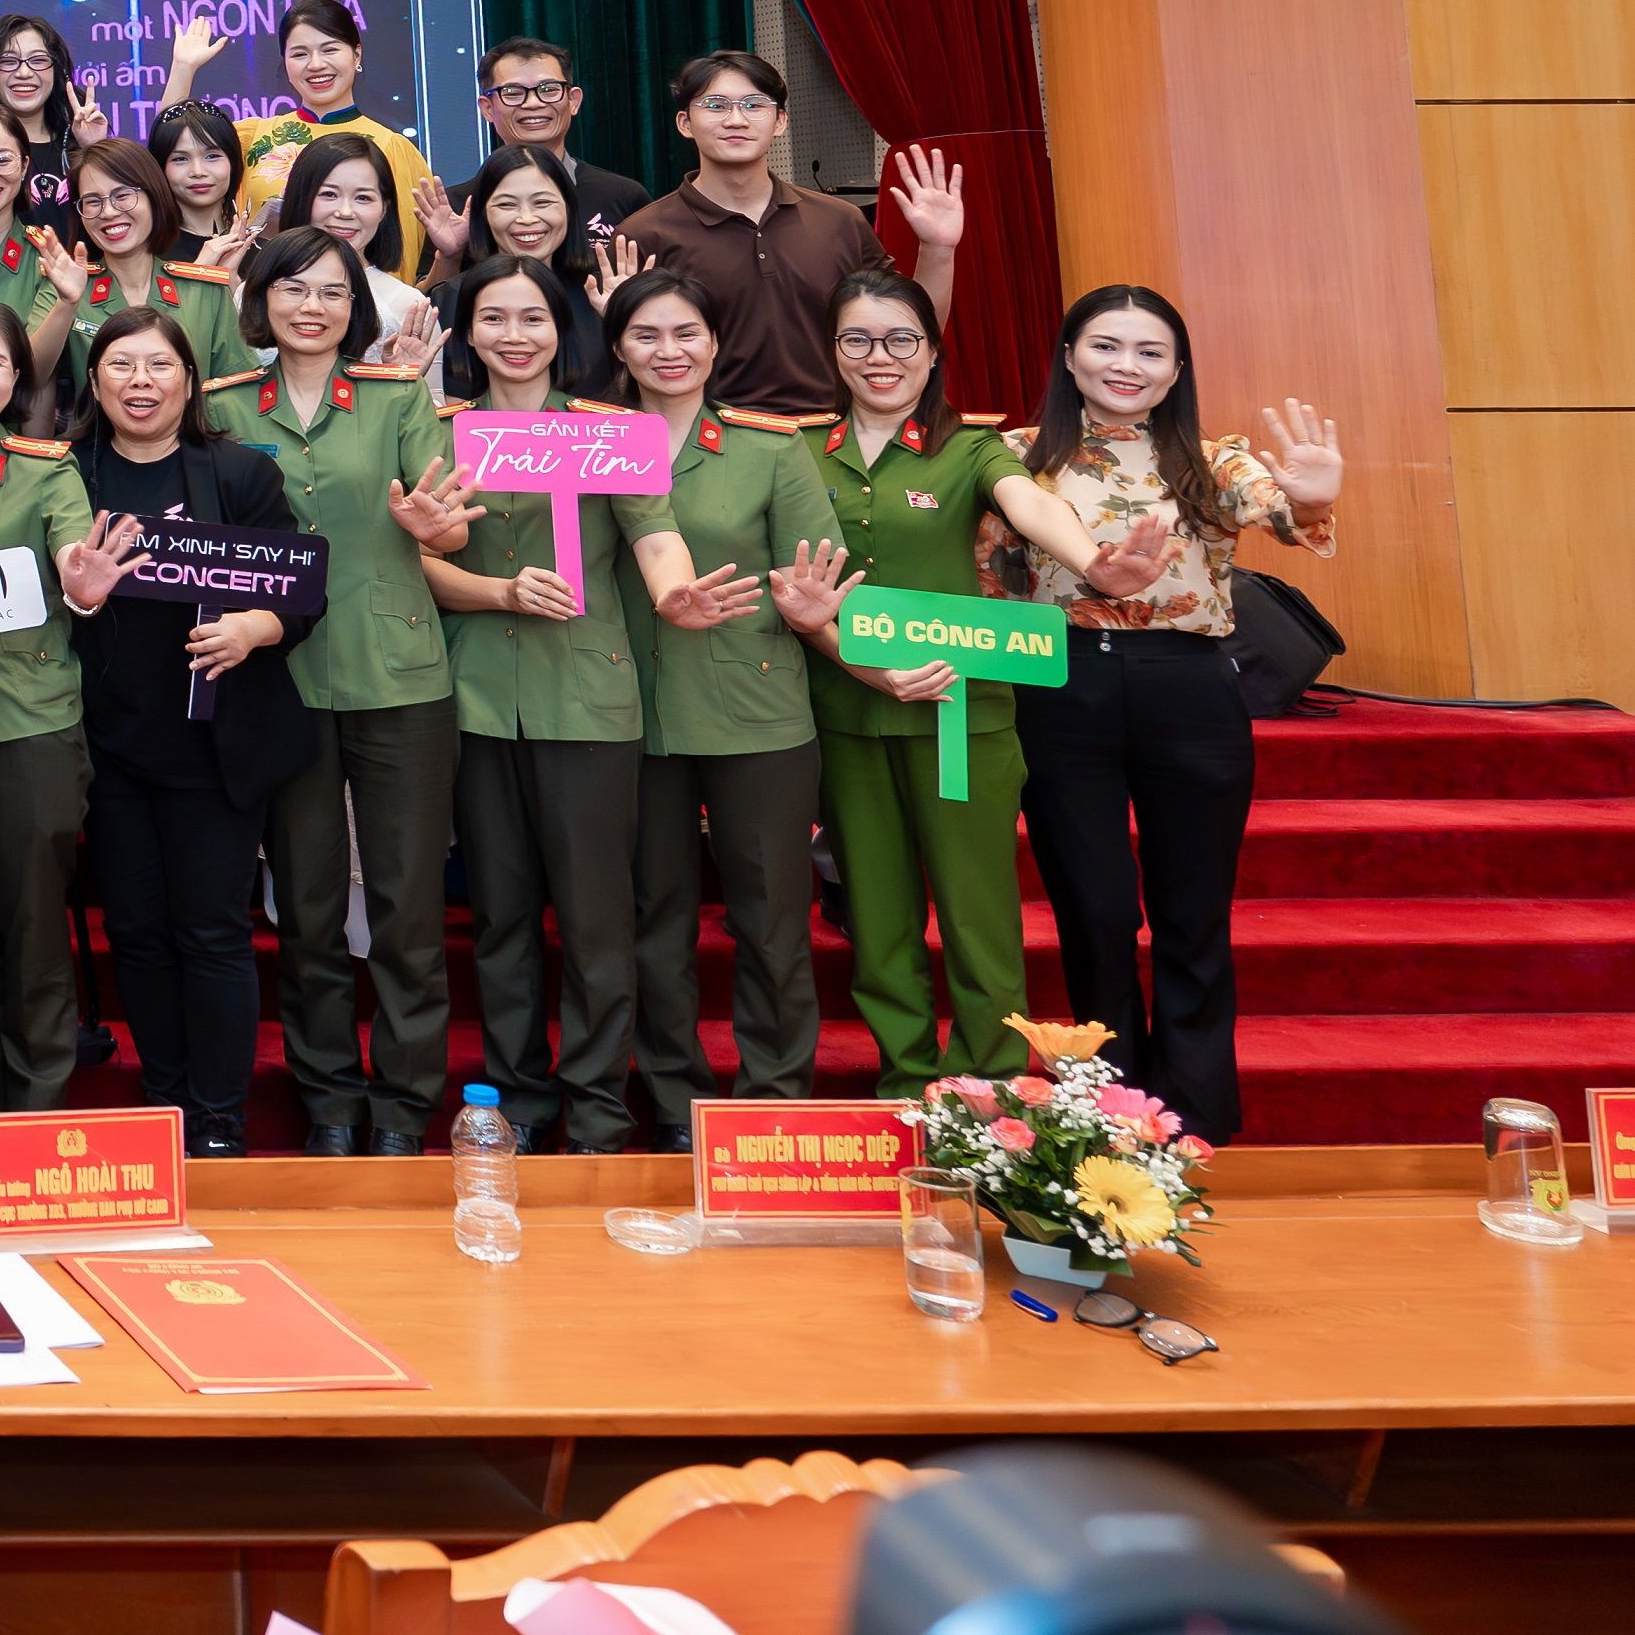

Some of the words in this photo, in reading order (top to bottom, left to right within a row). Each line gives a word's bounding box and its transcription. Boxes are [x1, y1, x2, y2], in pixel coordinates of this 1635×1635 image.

[91, 14, 155, 42] một
[115, 58, 166, 87] ấm
[530, 418, 579, 438] GẮN
[586, 419, 630, 439] KẾT
[469, 427, 562, 482] Trái
[168, 536, 226, 557] XINH
[133, 561, 297, 596] CONCERT
[851, 611, 897, 643] BỘ
[904, 611, 998, 651] CÔNG
[1005, 629, 1054, 657] AN
[736, 1125, 795, 1163] NGUYỄN
[796, 1135, 822, 1169] THỊ
[822, 1135, 864, 1169] NGỌC
[865, 1129, 901, 1169] DIỆP
[34, 1162, 73, 1196] NGÔ
[76, 1160, 118, 1194] HOÀI
[120, 1163, 154, 1192] THU
